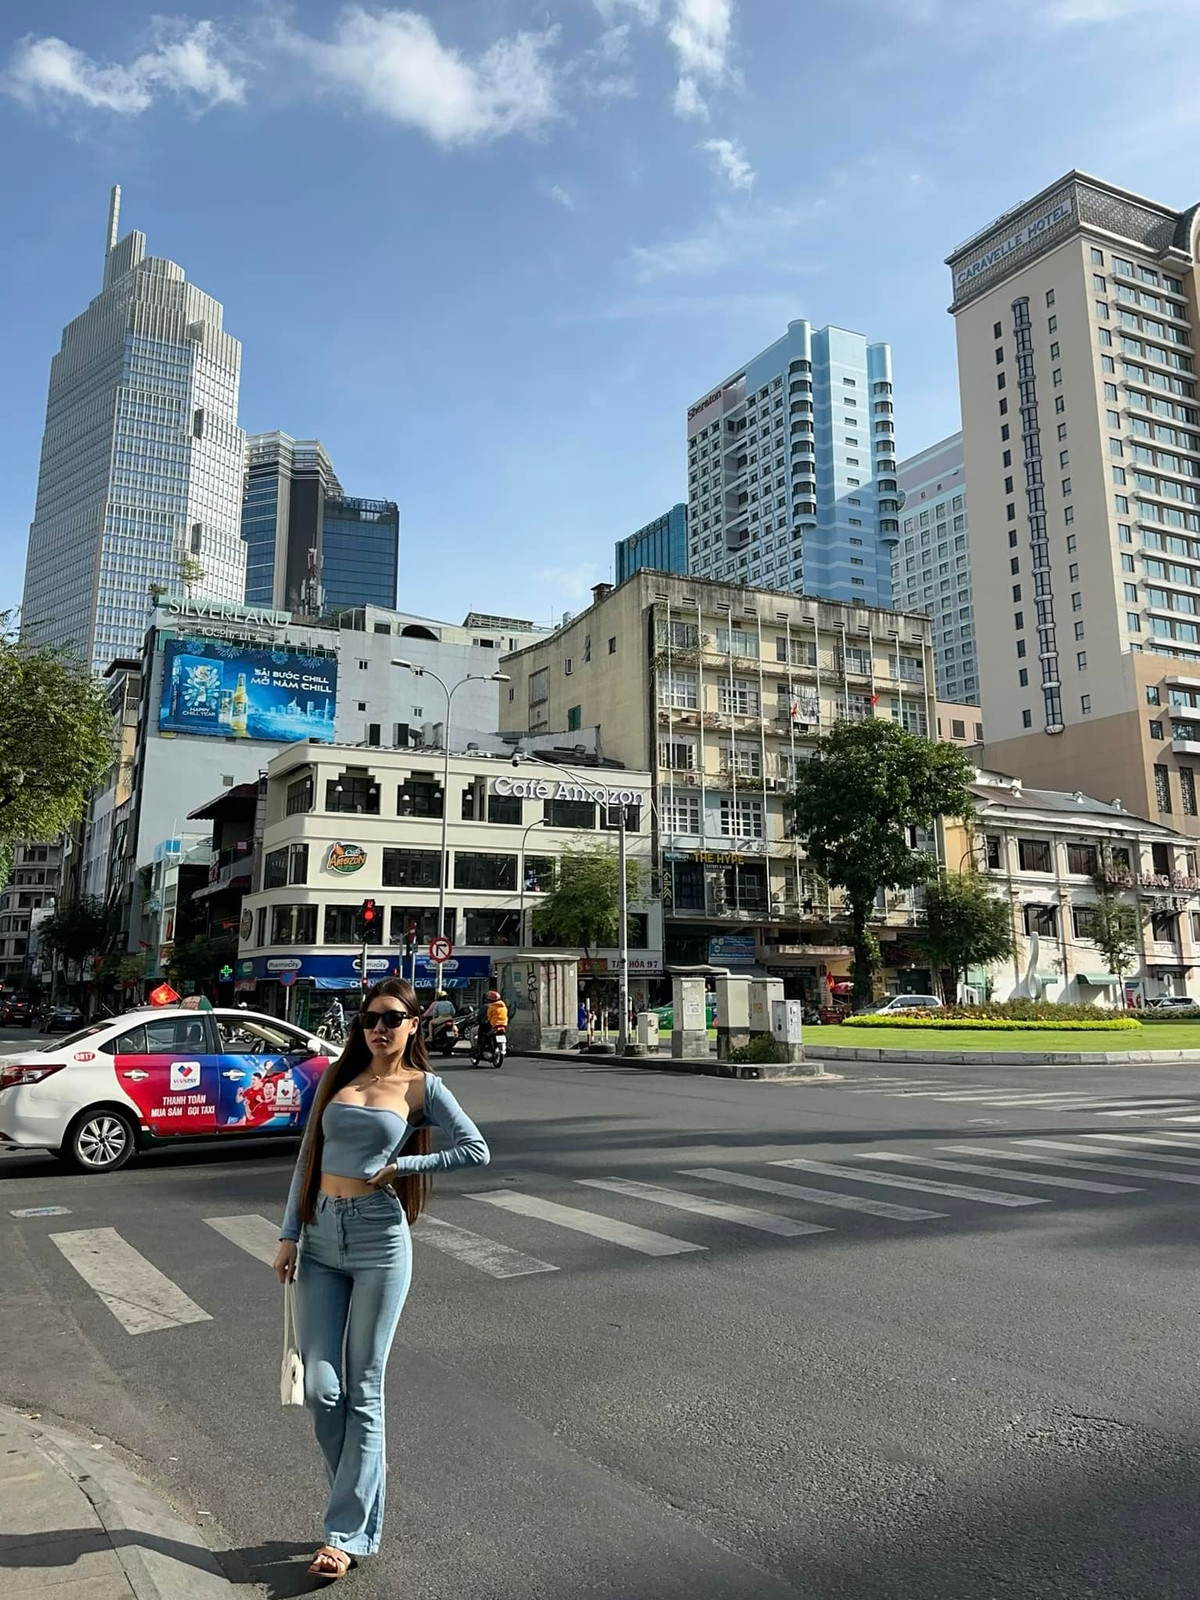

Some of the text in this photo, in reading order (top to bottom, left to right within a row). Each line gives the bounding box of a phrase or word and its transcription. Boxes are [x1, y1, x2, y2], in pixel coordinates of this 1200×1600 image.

[958, 204, 1069, 283] CARAVELLE HOTEL
[168, 598, 290, 628] SILVERLAND
[273, 671, 300, 680] BƯỚC
[302, 675, 329, 684] CHILL
[301, 683, 332, 693] CHILL
[494, 776, 645, 805] Café Amazon
[694, 850, 714, 863] THE
[717, 852, 744, 865] HYPE
[162, 1094, 207, 1106] THANH TOÁN
[151, 1108, 166, 1118] MUA
[200, 1105, 216, 1115] TAXI
